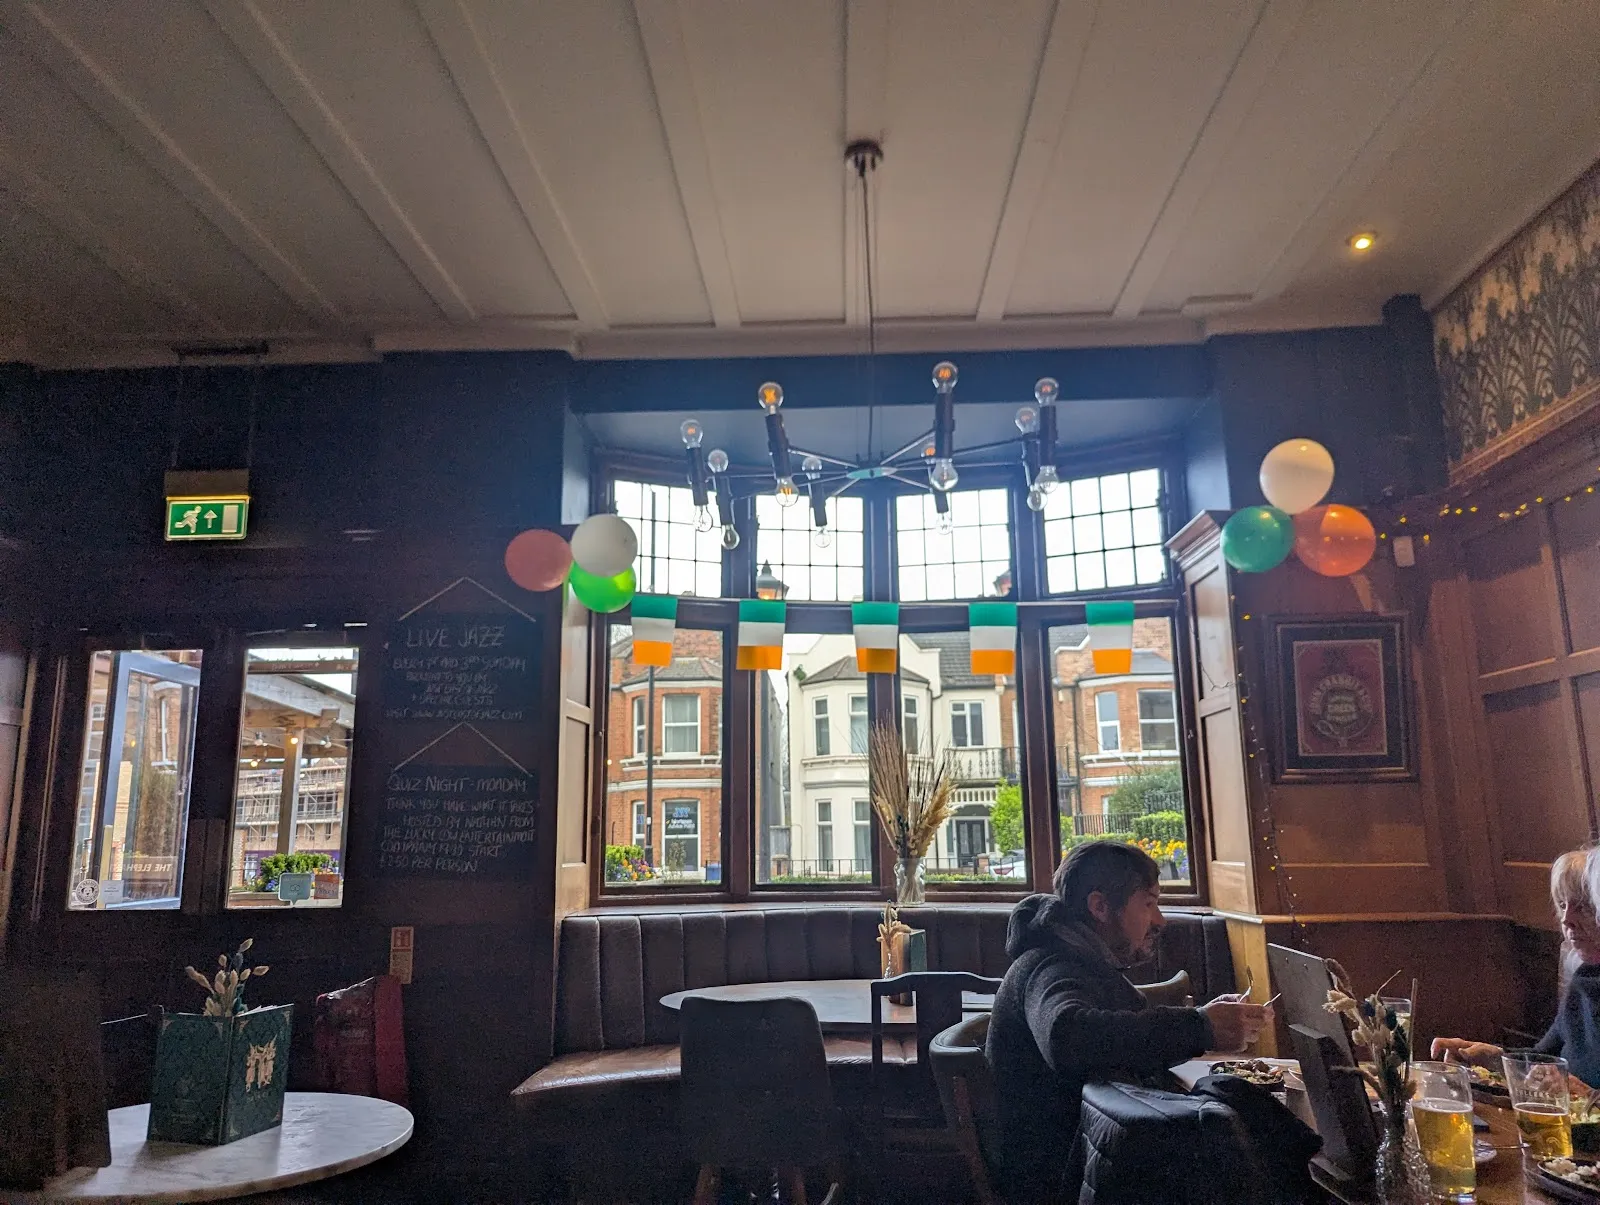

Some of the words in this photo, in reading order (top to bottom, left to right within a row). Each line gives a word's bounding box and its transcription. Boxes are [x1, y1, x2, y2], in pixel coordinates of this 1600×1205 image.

[407, 628, 451, 648] LIVE
[458, 625, 506, 648] JAZZ
[387, 773, 422, 791] QUIZ
[425, 775, 470, 792] NIGHT
[476, 777, 527, 792] MONDAY
[403, 814, 443, 828] HOSTED
[446, 815, 461, 829] BY
[509, 815, 535, 828] FROM
[384, 826, 402, 839] THE
[467, 844, 503, 858] START
[411, 855, 434, 868] PER
[435, 857, 479, 873] PERSON
